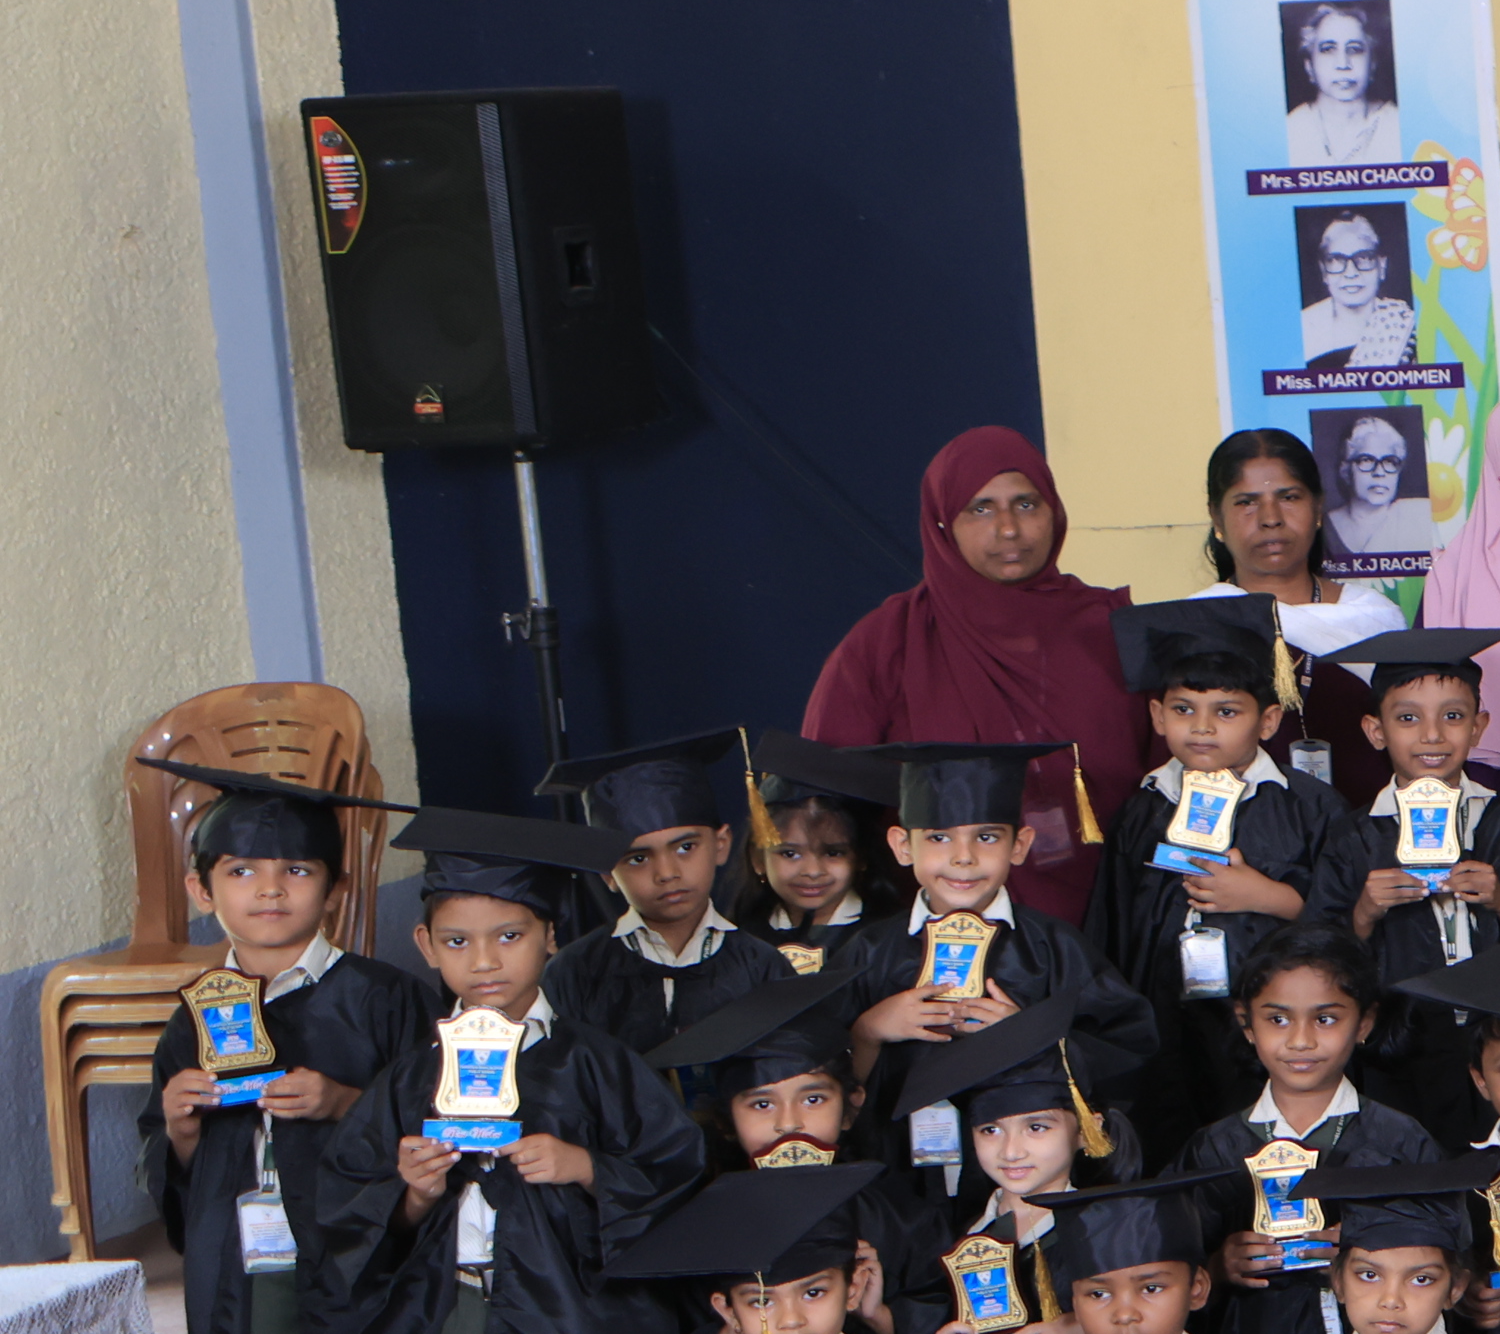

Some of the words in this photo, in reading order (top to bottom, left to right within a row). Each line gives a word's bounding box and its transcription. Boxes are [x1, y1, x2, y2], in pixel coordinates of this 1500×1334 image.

[1260, 173, 1297, 189] Mrs.
[1298, 169, 1360, 188] SUSAN
[1361, 166, 1435, 184] CHACKO
[1275, 374, 1316, 390] Miss.
[1318, 371, 1369, 388] MARY
[1371, 368, 1452, 386] OOMMEN
[1382, 555, 1432, 571] RACHE
